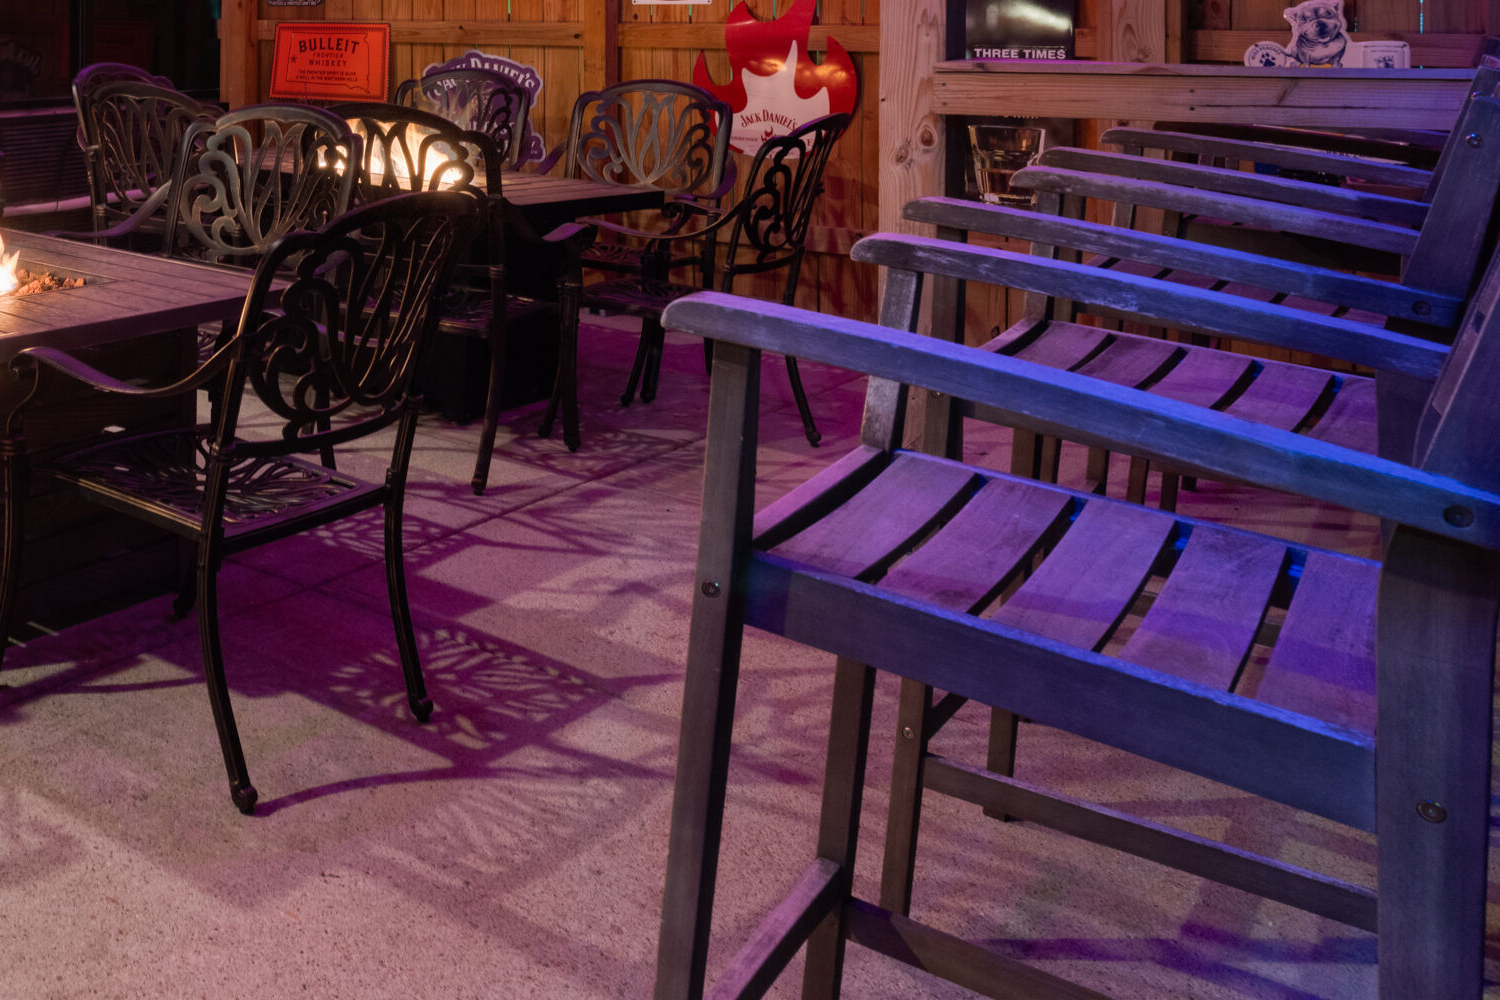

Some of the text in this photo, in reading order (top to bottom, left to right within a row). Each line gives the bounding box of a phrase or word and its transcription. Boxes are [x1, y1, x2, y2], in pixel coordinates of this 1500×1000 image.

[299, 37, 360, 54] BULLEIT
[974, 48, 1067, 60] THREE TIMES
[309, 59, 347, 67] WHISKEY
[740, 109, 798, 132] JACK DANIEL'S
